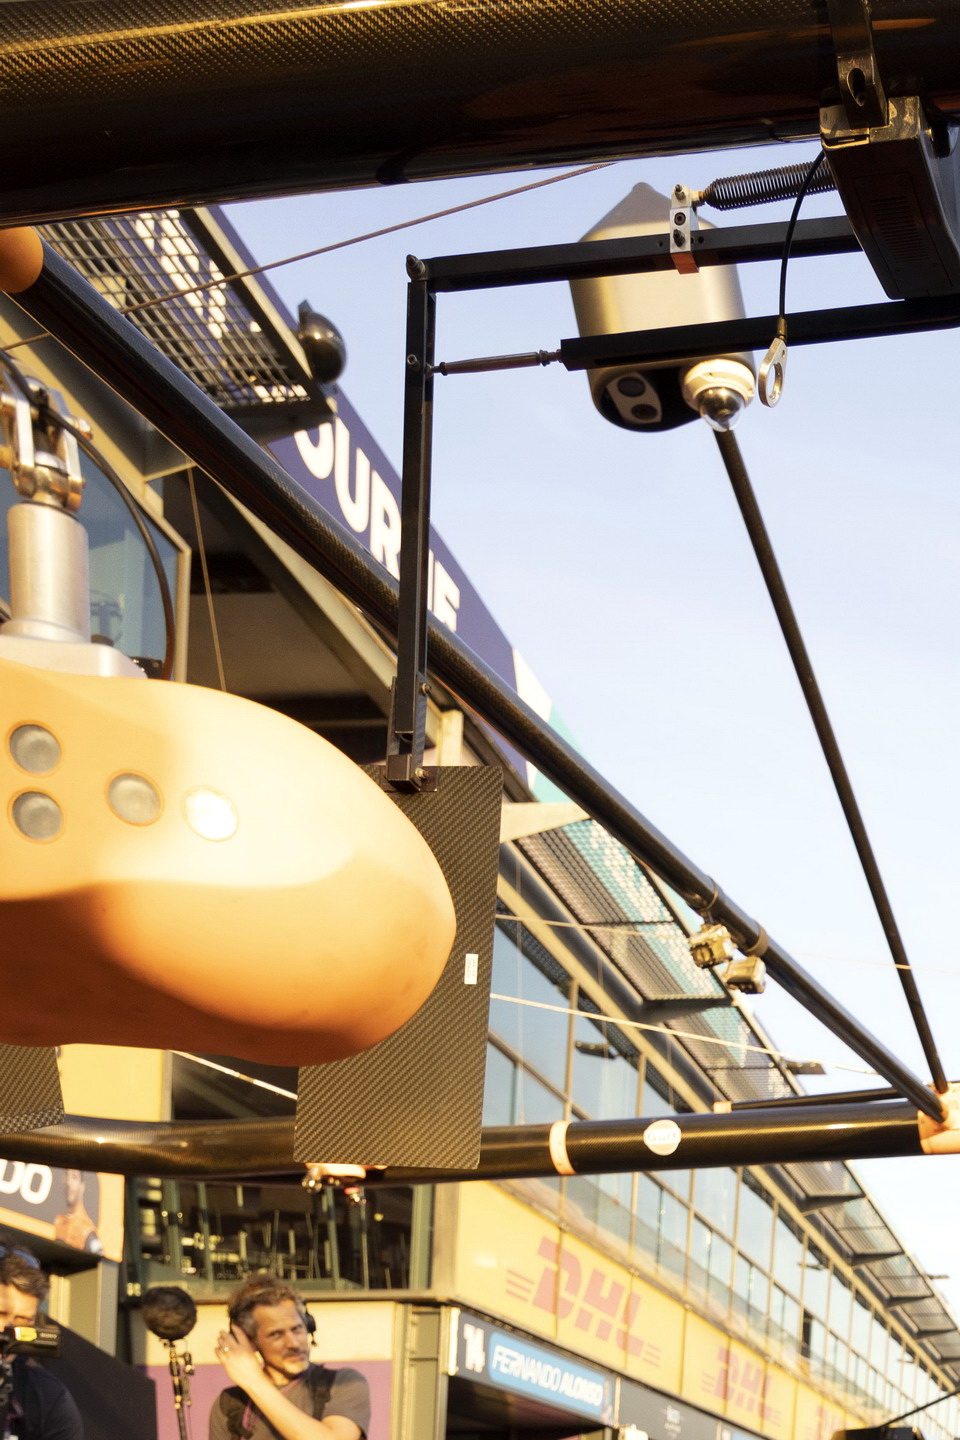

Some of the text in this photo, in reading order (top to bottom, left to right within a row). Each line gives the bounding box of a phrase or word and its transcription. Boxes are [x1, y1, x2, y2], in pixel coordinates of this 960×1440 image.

[532, 1236, 644, 1358] DHL
[463, 1323, 485, 1373] 14
[491, 1344, 562, 1392] FERNANDO
[714, 1345, 772, 1419] DHL
